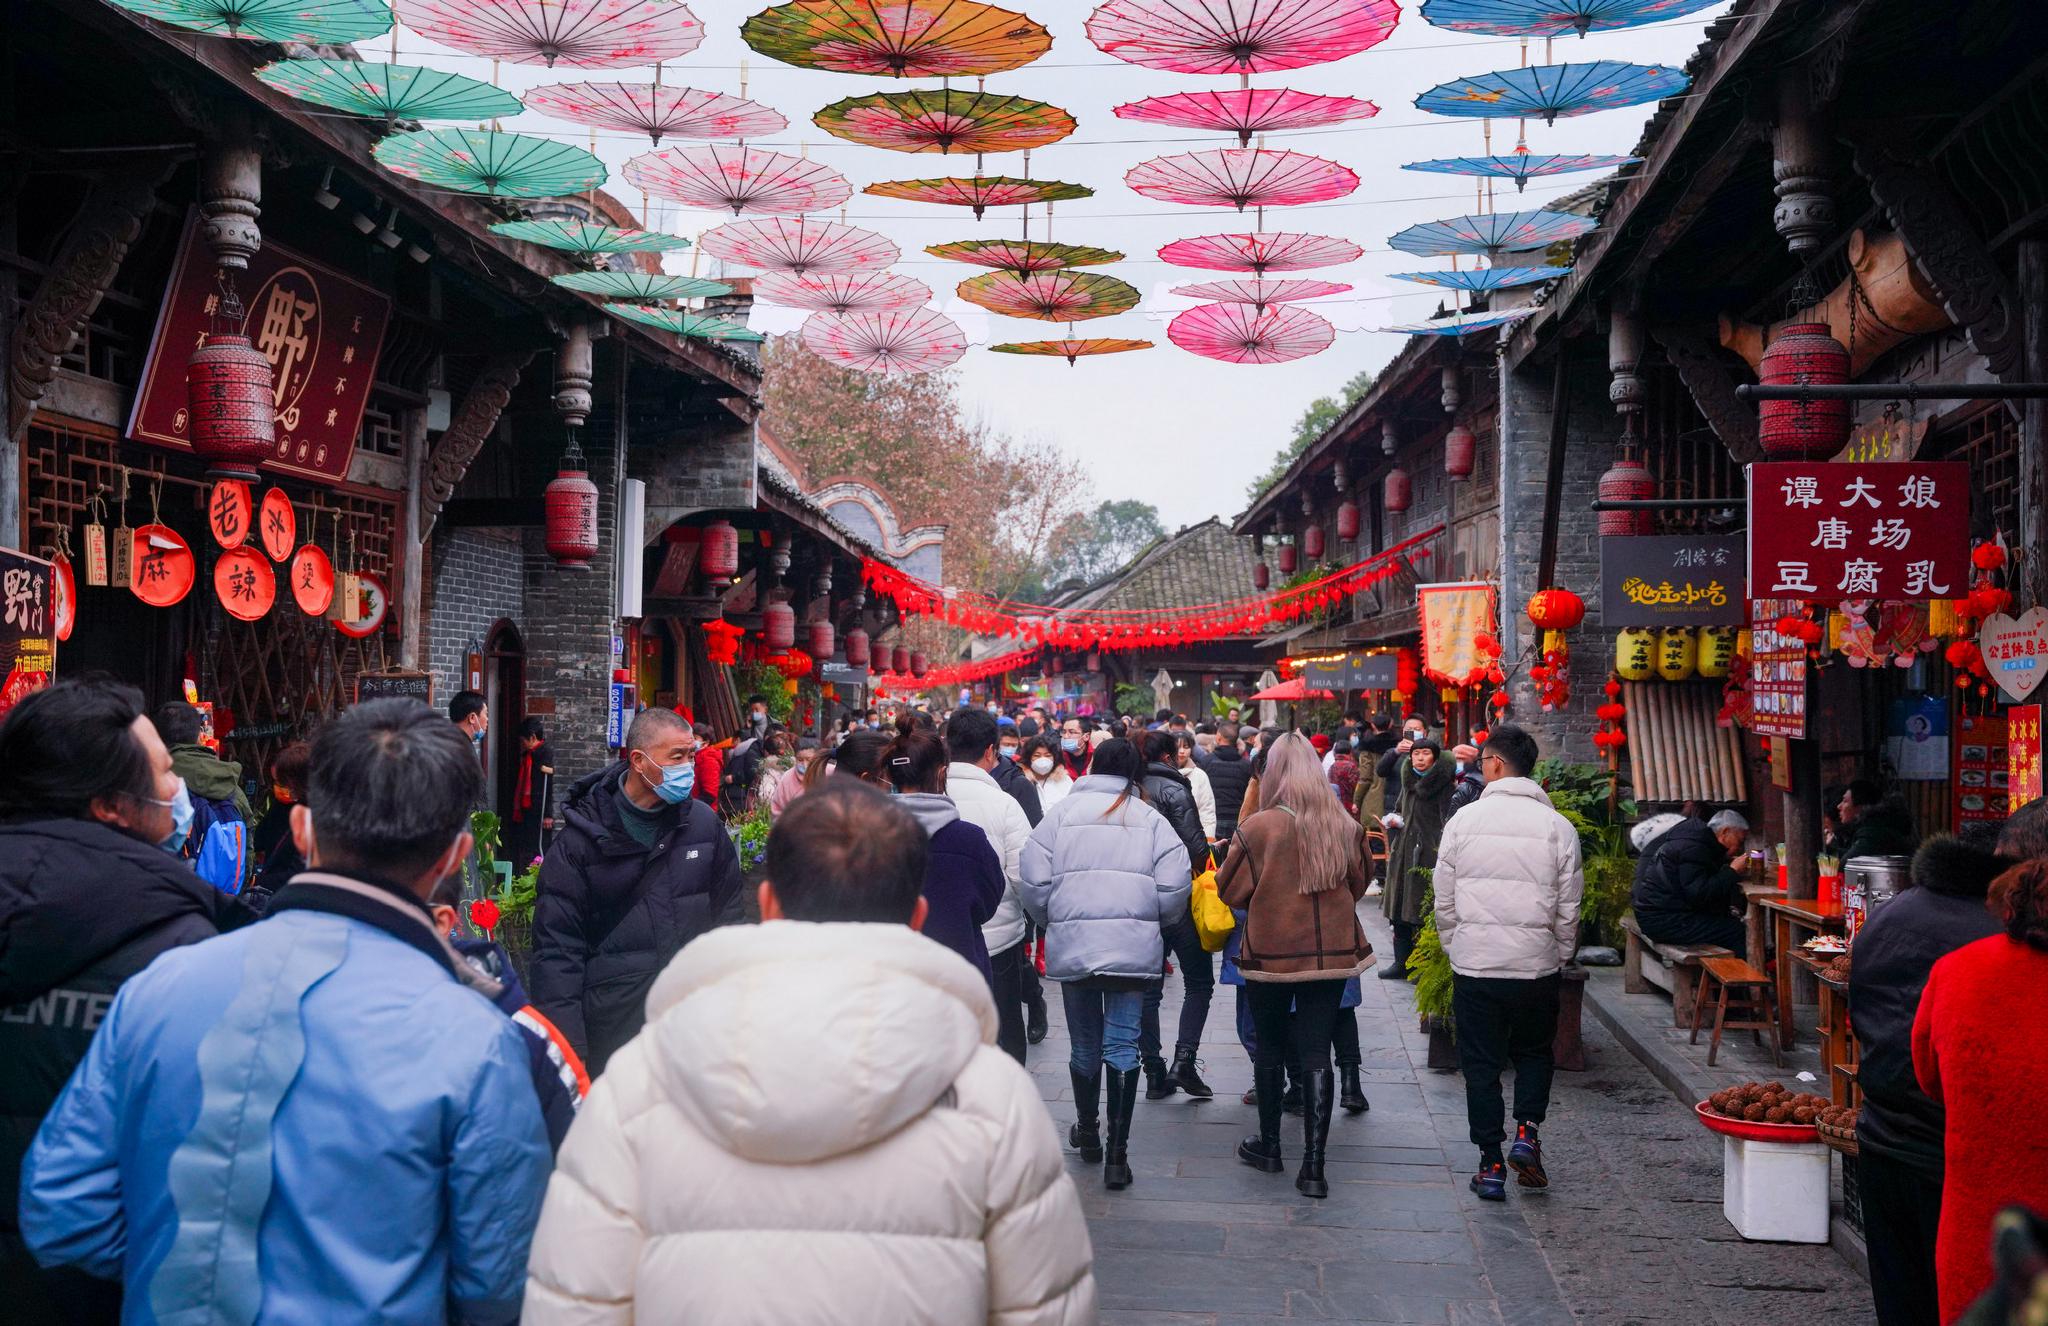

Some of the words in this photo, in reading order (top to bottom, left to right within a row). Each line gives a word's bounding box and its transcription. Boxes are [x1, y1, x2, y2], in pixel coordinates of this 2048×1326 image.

[1780, 475, 1941, 509] 谭大娘
[214, 487, 238, 537] 老
[1810, 516, 1911, 551] 唐场
[138, 544, 170, 588] 麻
[229, 564, 256, 602] 辣
[1772, 557, 1950, 595] 豆腐乳
[4, 568, 33, 632] 野
[1625, 579, 1727, 606] 地主小吃
[1989, 638, 2048, 659] 公益休息点
[611, 688, 620, 709] SOS
